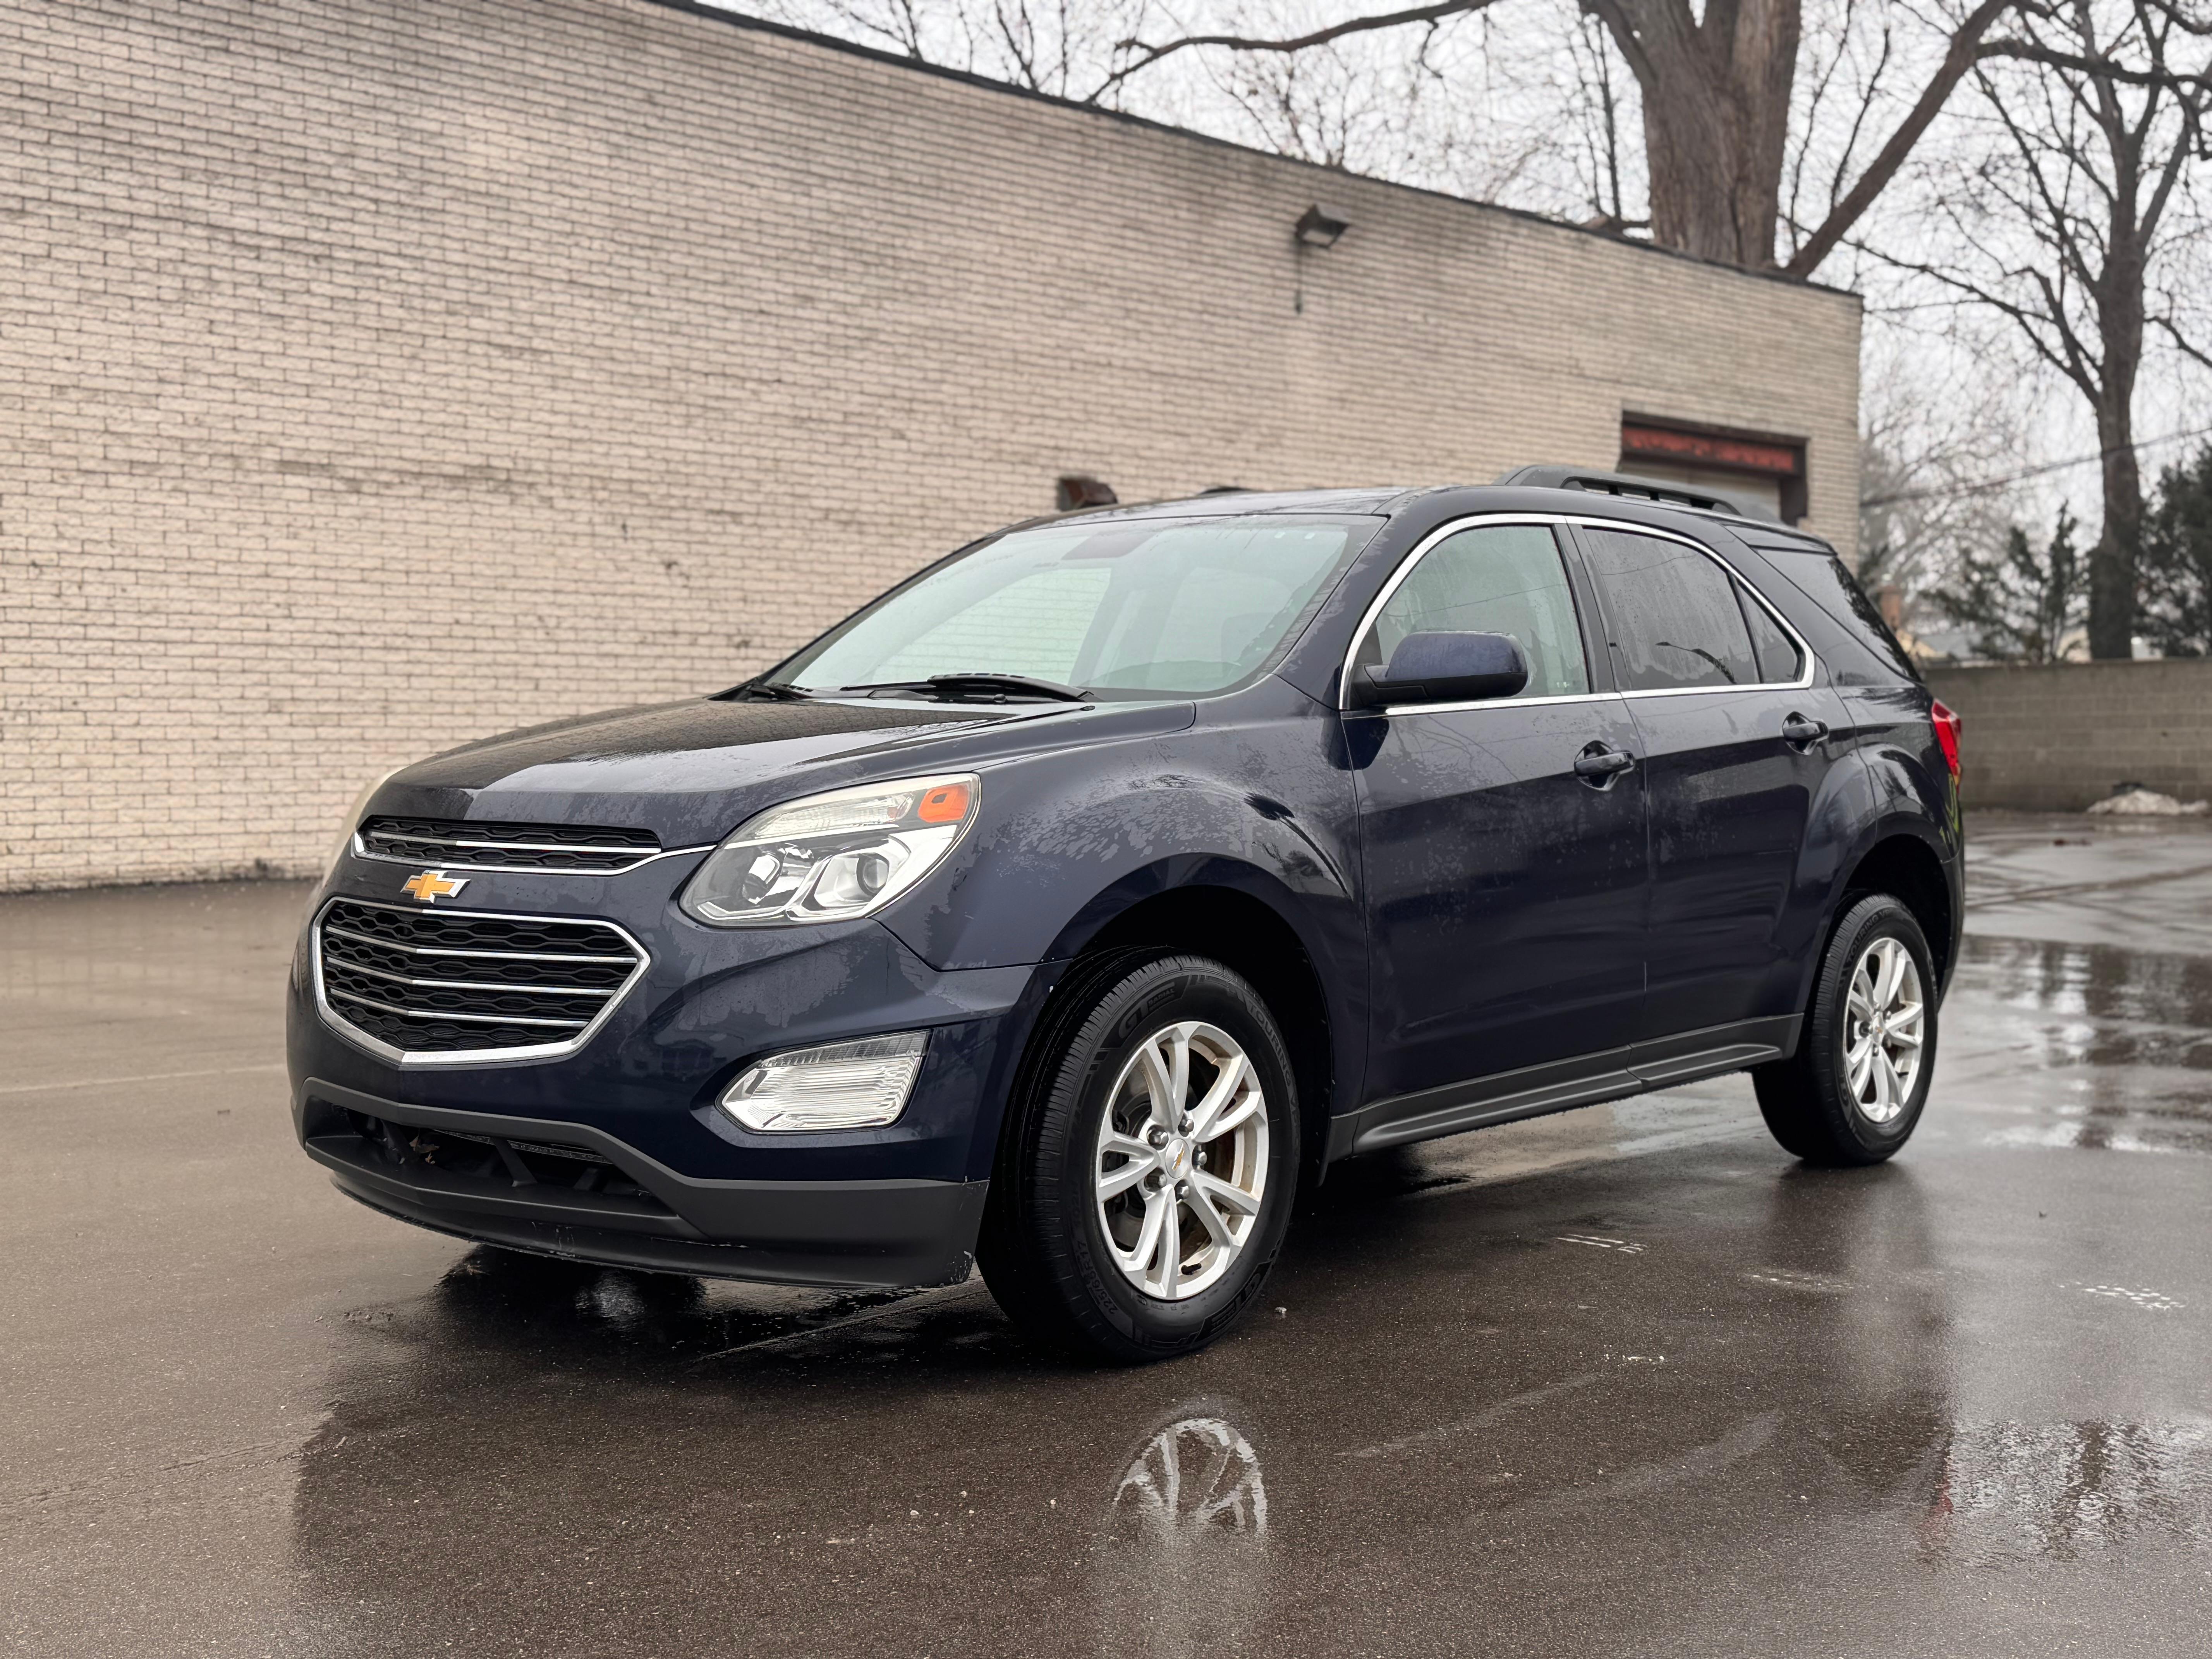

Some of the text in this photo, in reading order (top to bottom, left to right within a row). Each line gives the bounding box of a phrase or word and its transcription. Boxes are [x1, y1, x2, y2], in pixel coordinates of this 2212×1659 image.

[1846, 914, 1878, 963] TOURING
[1118, 981, 1175, 1039] GT
[1148, 988, 1175, 1005] RADIAL
[1250, 1000, 1291, 1087] TOURING
